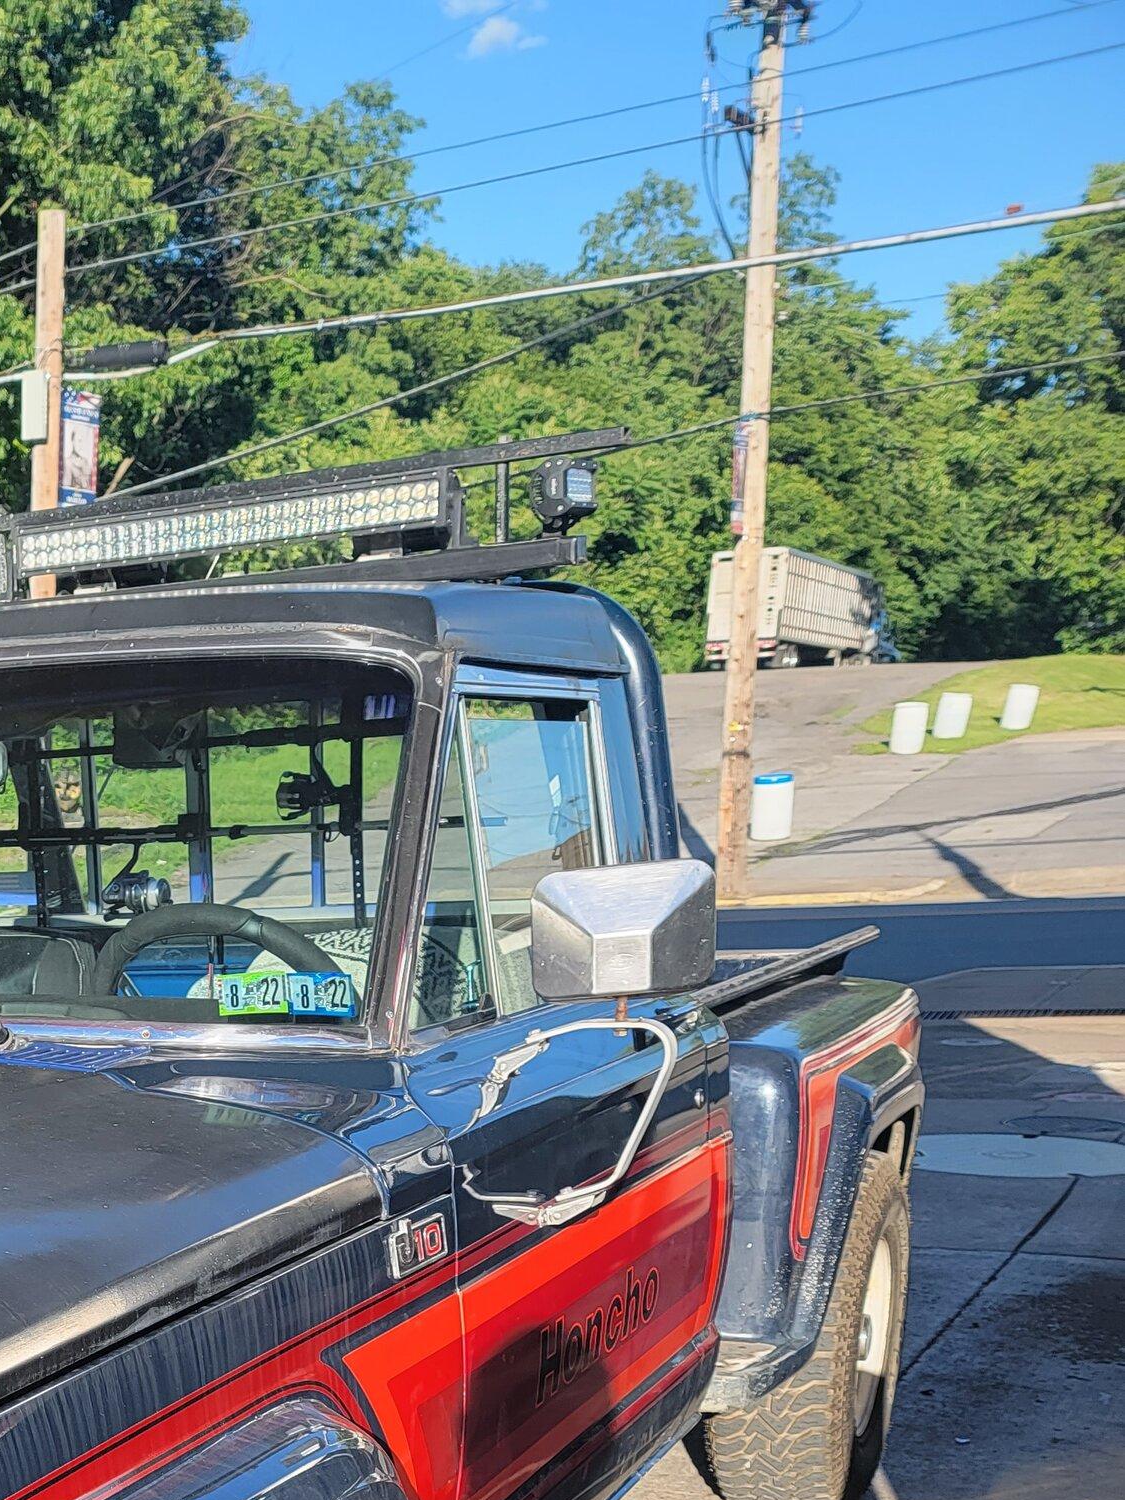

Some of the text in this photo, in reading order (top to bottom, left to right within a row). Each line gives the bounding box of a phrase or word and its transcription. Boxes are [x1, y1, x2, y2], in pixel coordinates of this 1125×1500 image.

[230, 976, 280, 1008] 8 22
[300, 979, 348, 1008] 8 22
[535, 1266, 659, 1408] Honcho
